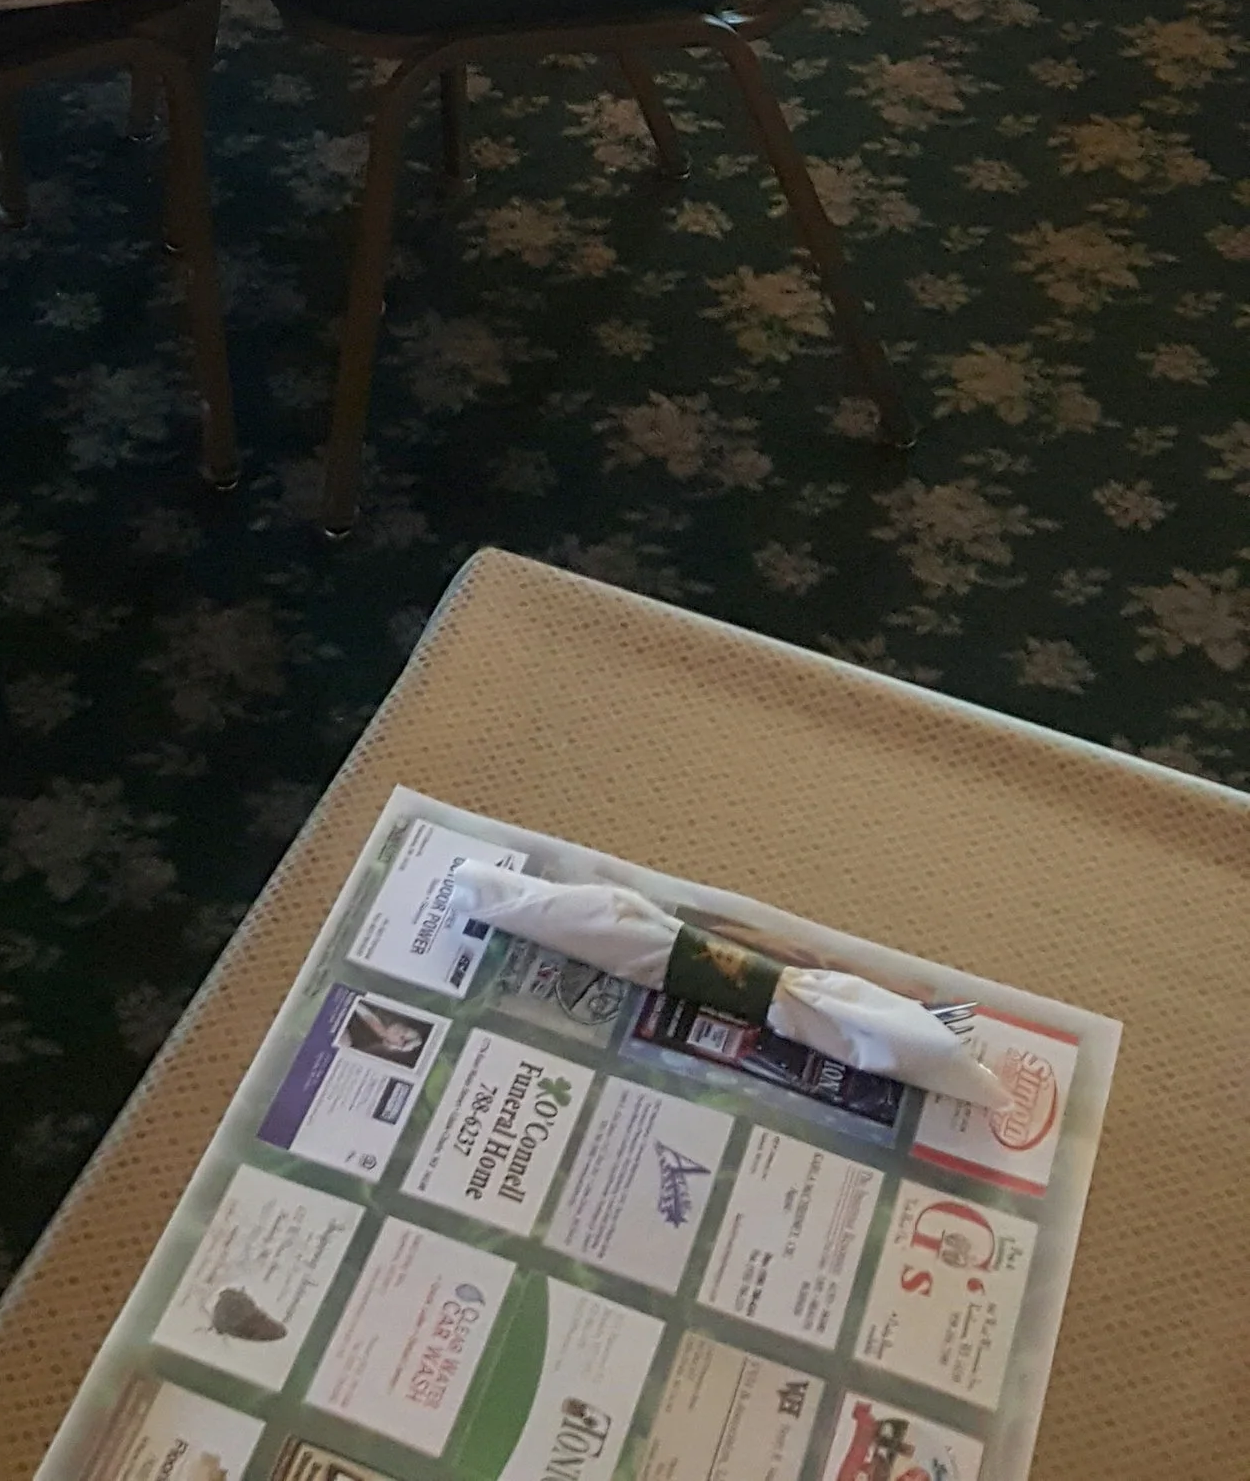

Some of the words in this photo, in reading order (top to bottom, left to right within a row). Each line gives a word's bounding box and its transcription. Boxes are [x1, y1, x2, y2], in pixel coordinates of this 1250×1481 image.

[410, 912, 441, 955] POWER
[453, 1082, 497, 1157] 788-6237
[492, 1060, 544, 1139] Funeral
[1002, 1051, 1053, 1142] Simon
[465, 1138, 511, 1201] Home
[497, 1098, 557, 1203] O'Connell
[431, 1302, 460, 1339] CAR
[405, 1347, 443, 1404] WASH
